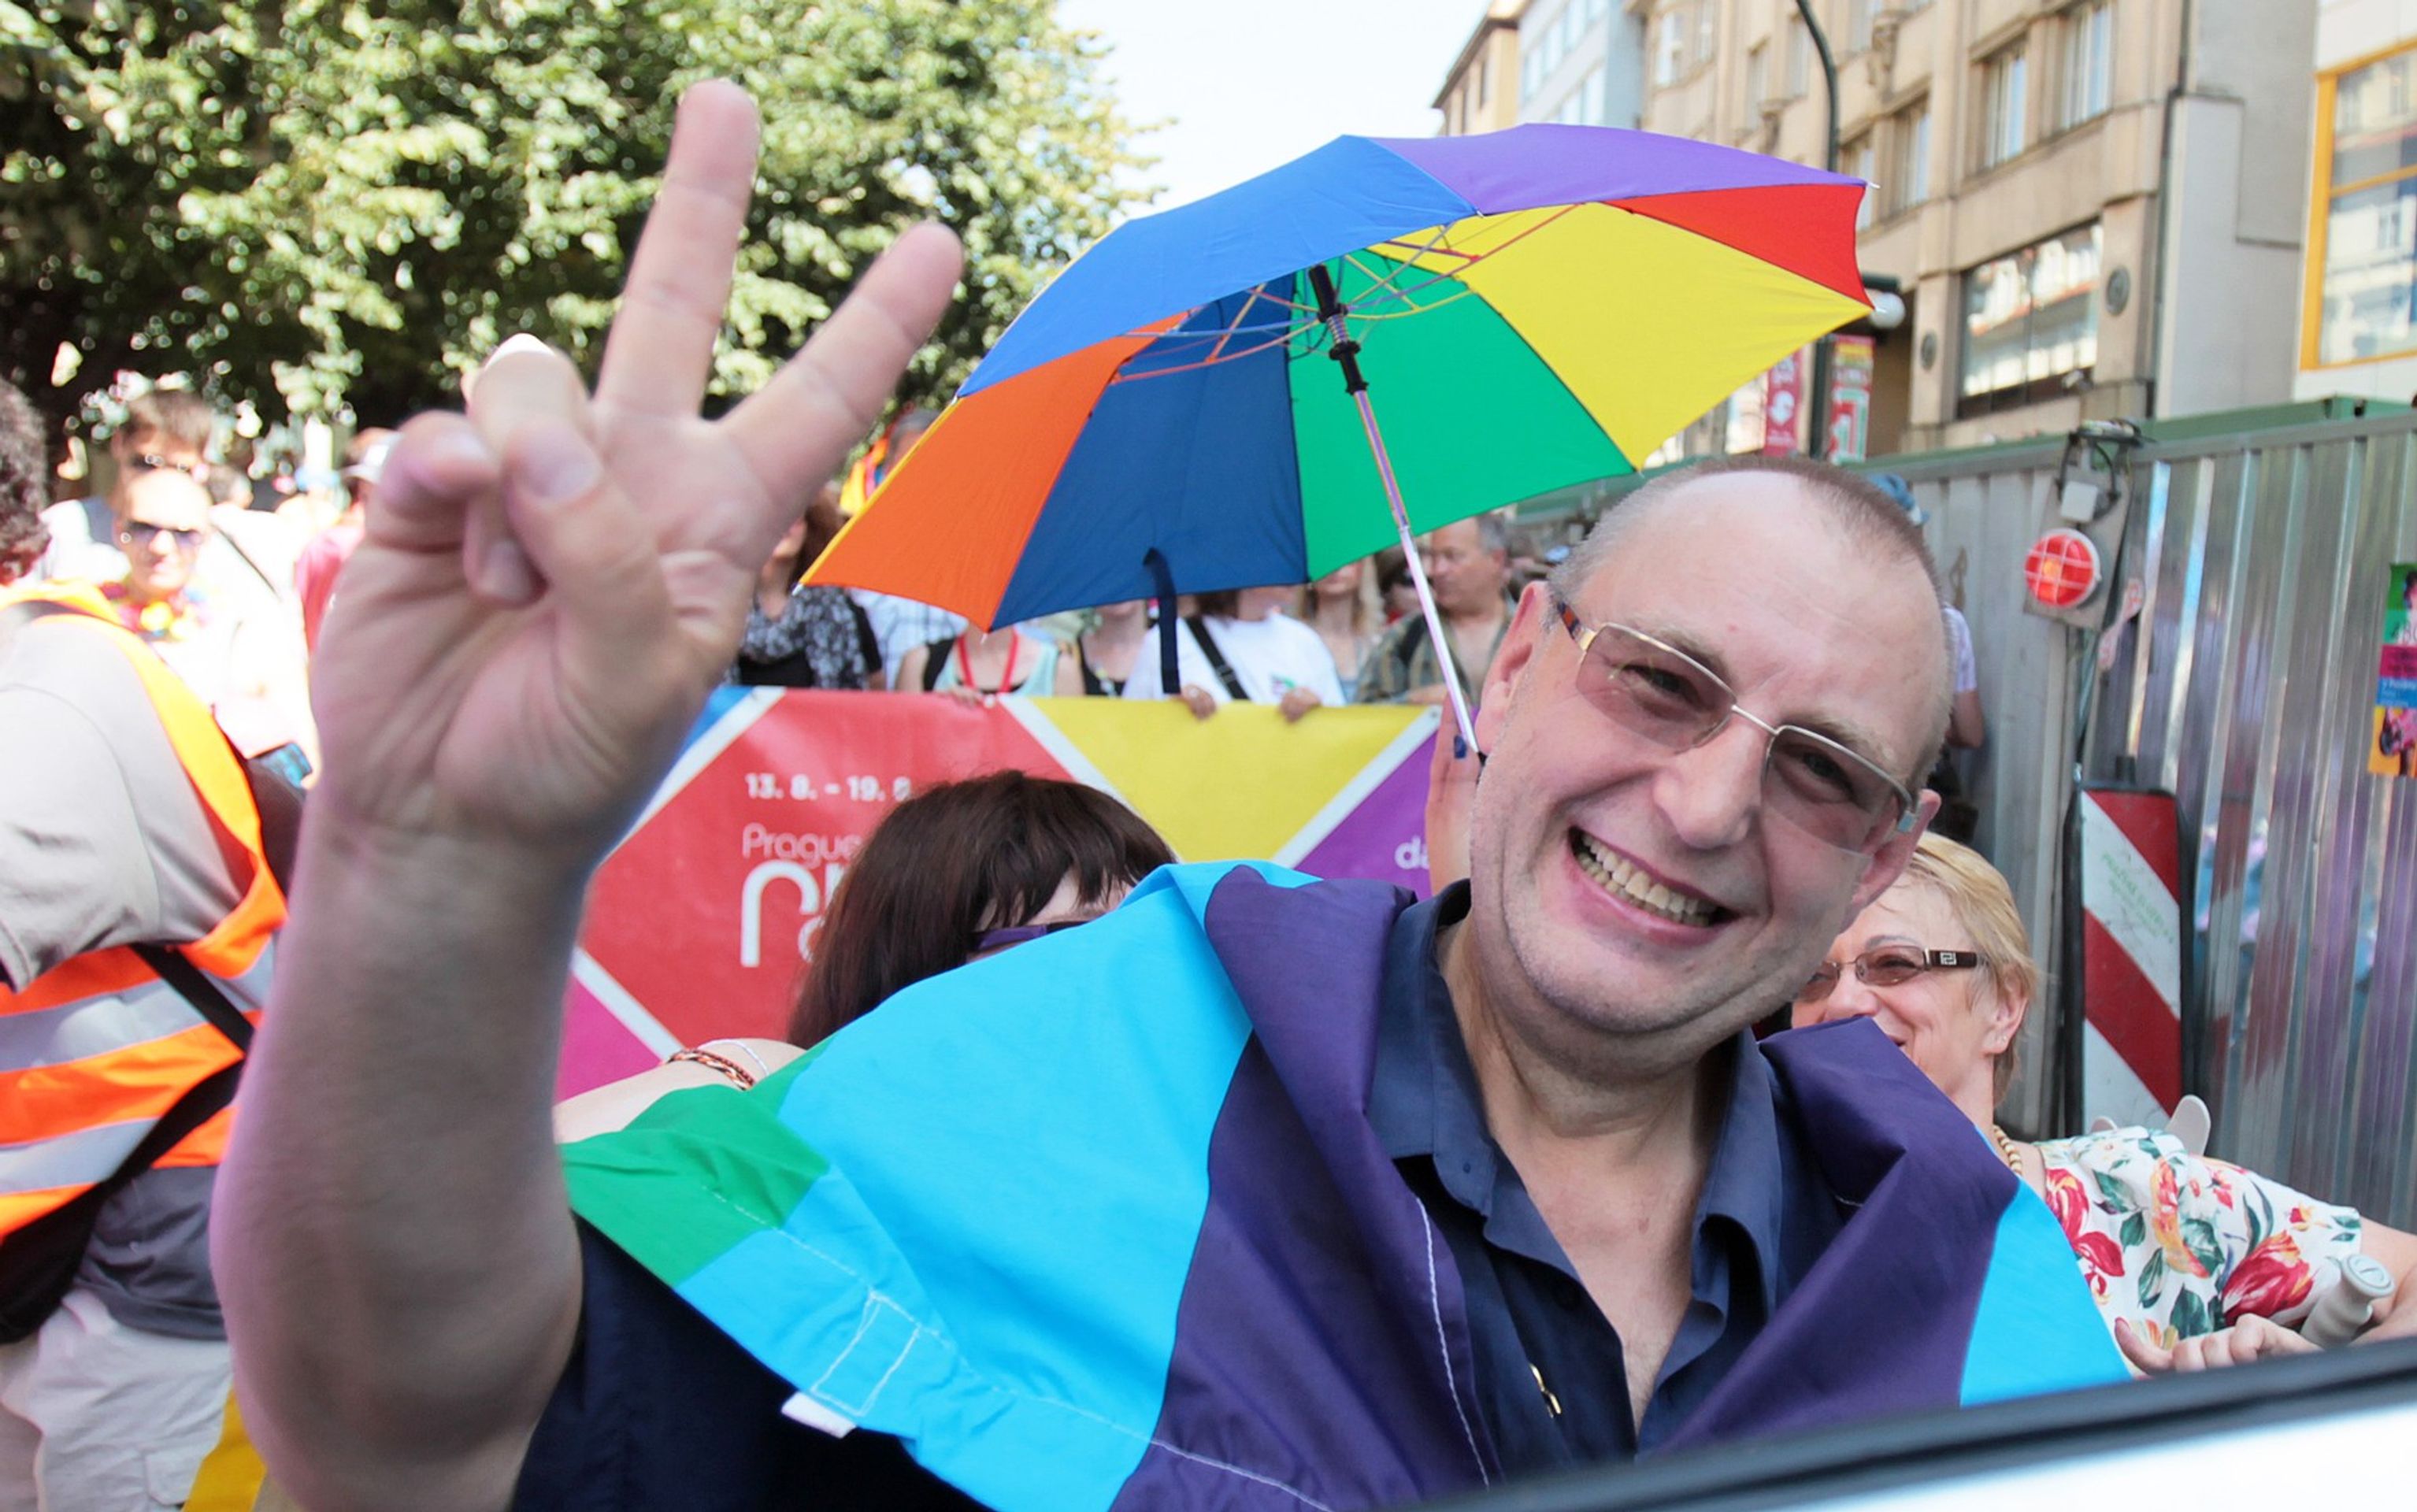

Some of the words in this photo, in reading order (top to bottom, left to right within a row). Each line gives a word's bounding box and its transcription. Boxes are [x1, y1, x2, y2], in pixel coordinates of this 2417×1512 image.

[745, 773, 784, 799] 13.
[790, 774, 817, 800] 8.
[847, 776, 885, 801] 19.
